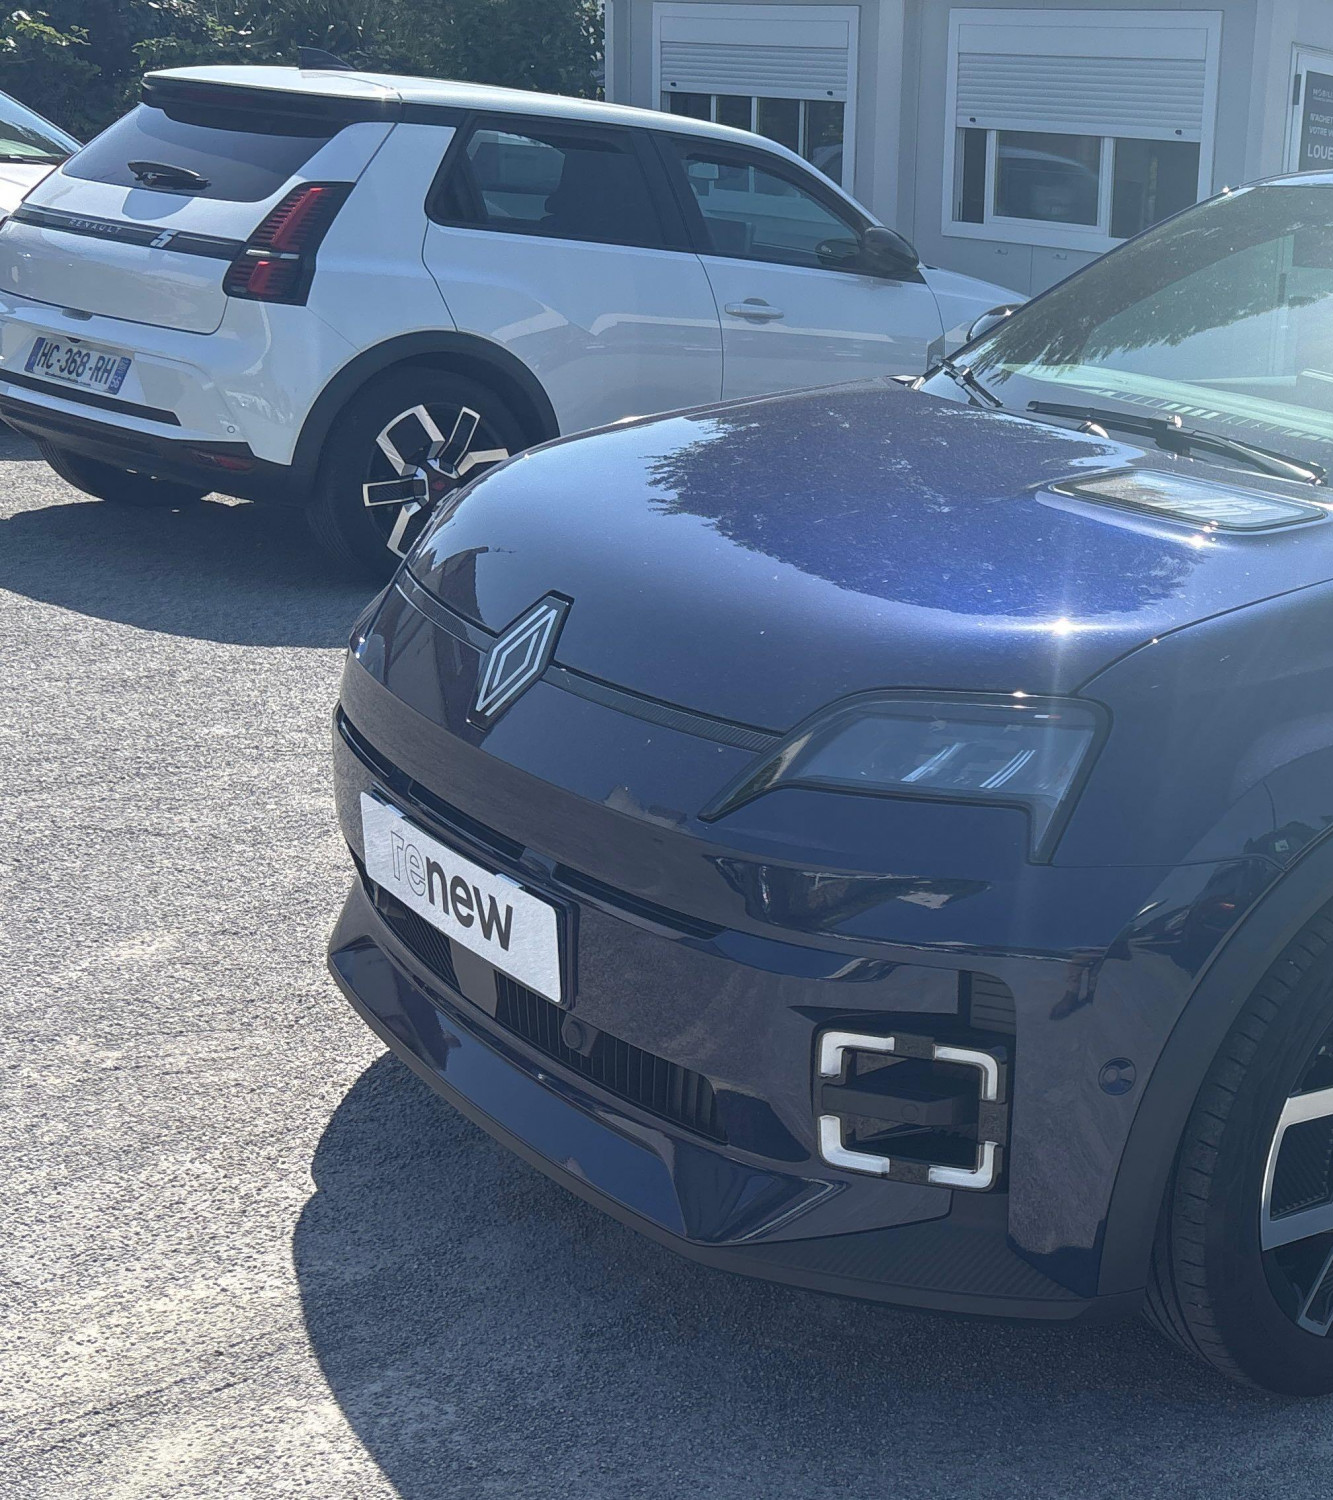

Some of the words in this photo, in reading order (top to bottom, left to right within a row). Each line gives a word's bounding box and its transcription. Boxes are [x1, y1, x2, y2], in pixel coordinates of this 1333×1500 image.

[1309, 126, 1327, 136] VOTRE
[68, 219, 122, 235] RENAULT
[37, 342, 116, 385] HC-368-RH
[390, 830, 514, 952] renew
